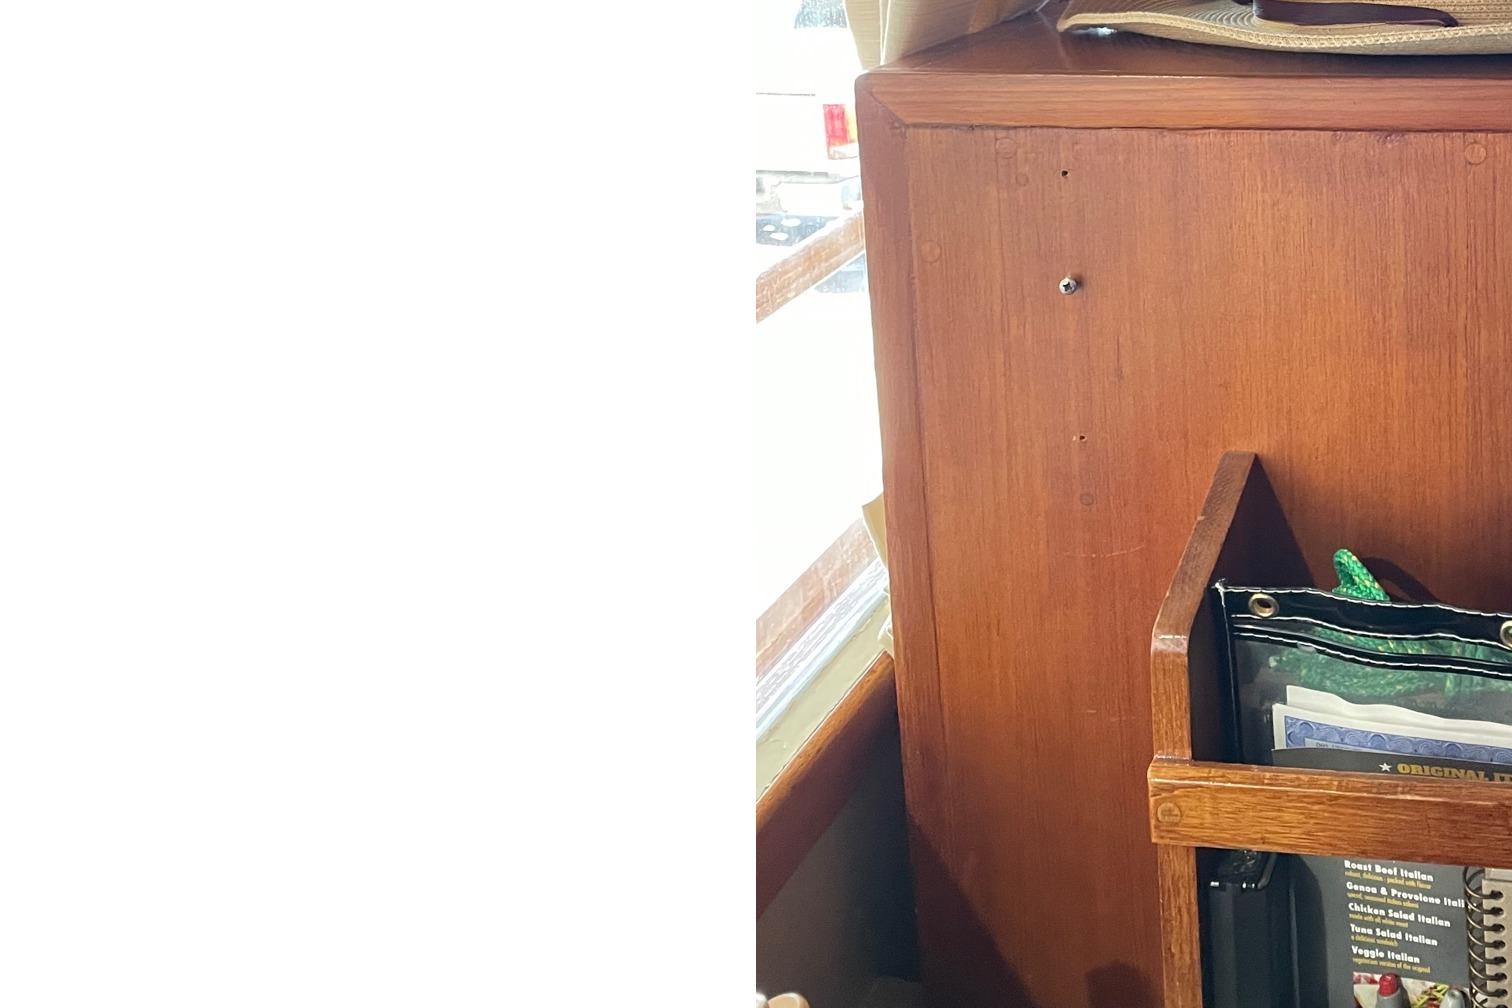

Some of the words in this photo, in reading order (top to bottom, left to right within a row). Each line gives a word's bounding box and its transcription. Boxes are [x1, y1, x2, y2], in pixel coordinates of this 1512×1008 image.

[1397, 763, 1488, 784] ORIGINAL
[1344, 859, 1372, 872] Roast
[1375, 864, 1398, 876] Beef
[1400, 868, 1434, 882] Italian
[1346, 881, 1377, 894] Genoa
[1380, 885, 1388, 895] &
[1391, 888, 1441, 904] Provolone
[1348, 902, 1385, 916] Chicken
[1388, 908, 1415, 921] Salad
[1418, 914, 1451, 927] Italian
[1350, 923, 1373, 935] Tuna
[1375, 927, 1403, 940] Salad
[1405, 932, 1438, 946] Italian
[1351, 945, 1385, 959] Veggie
[1387, 950, 1420, 964] Italian
